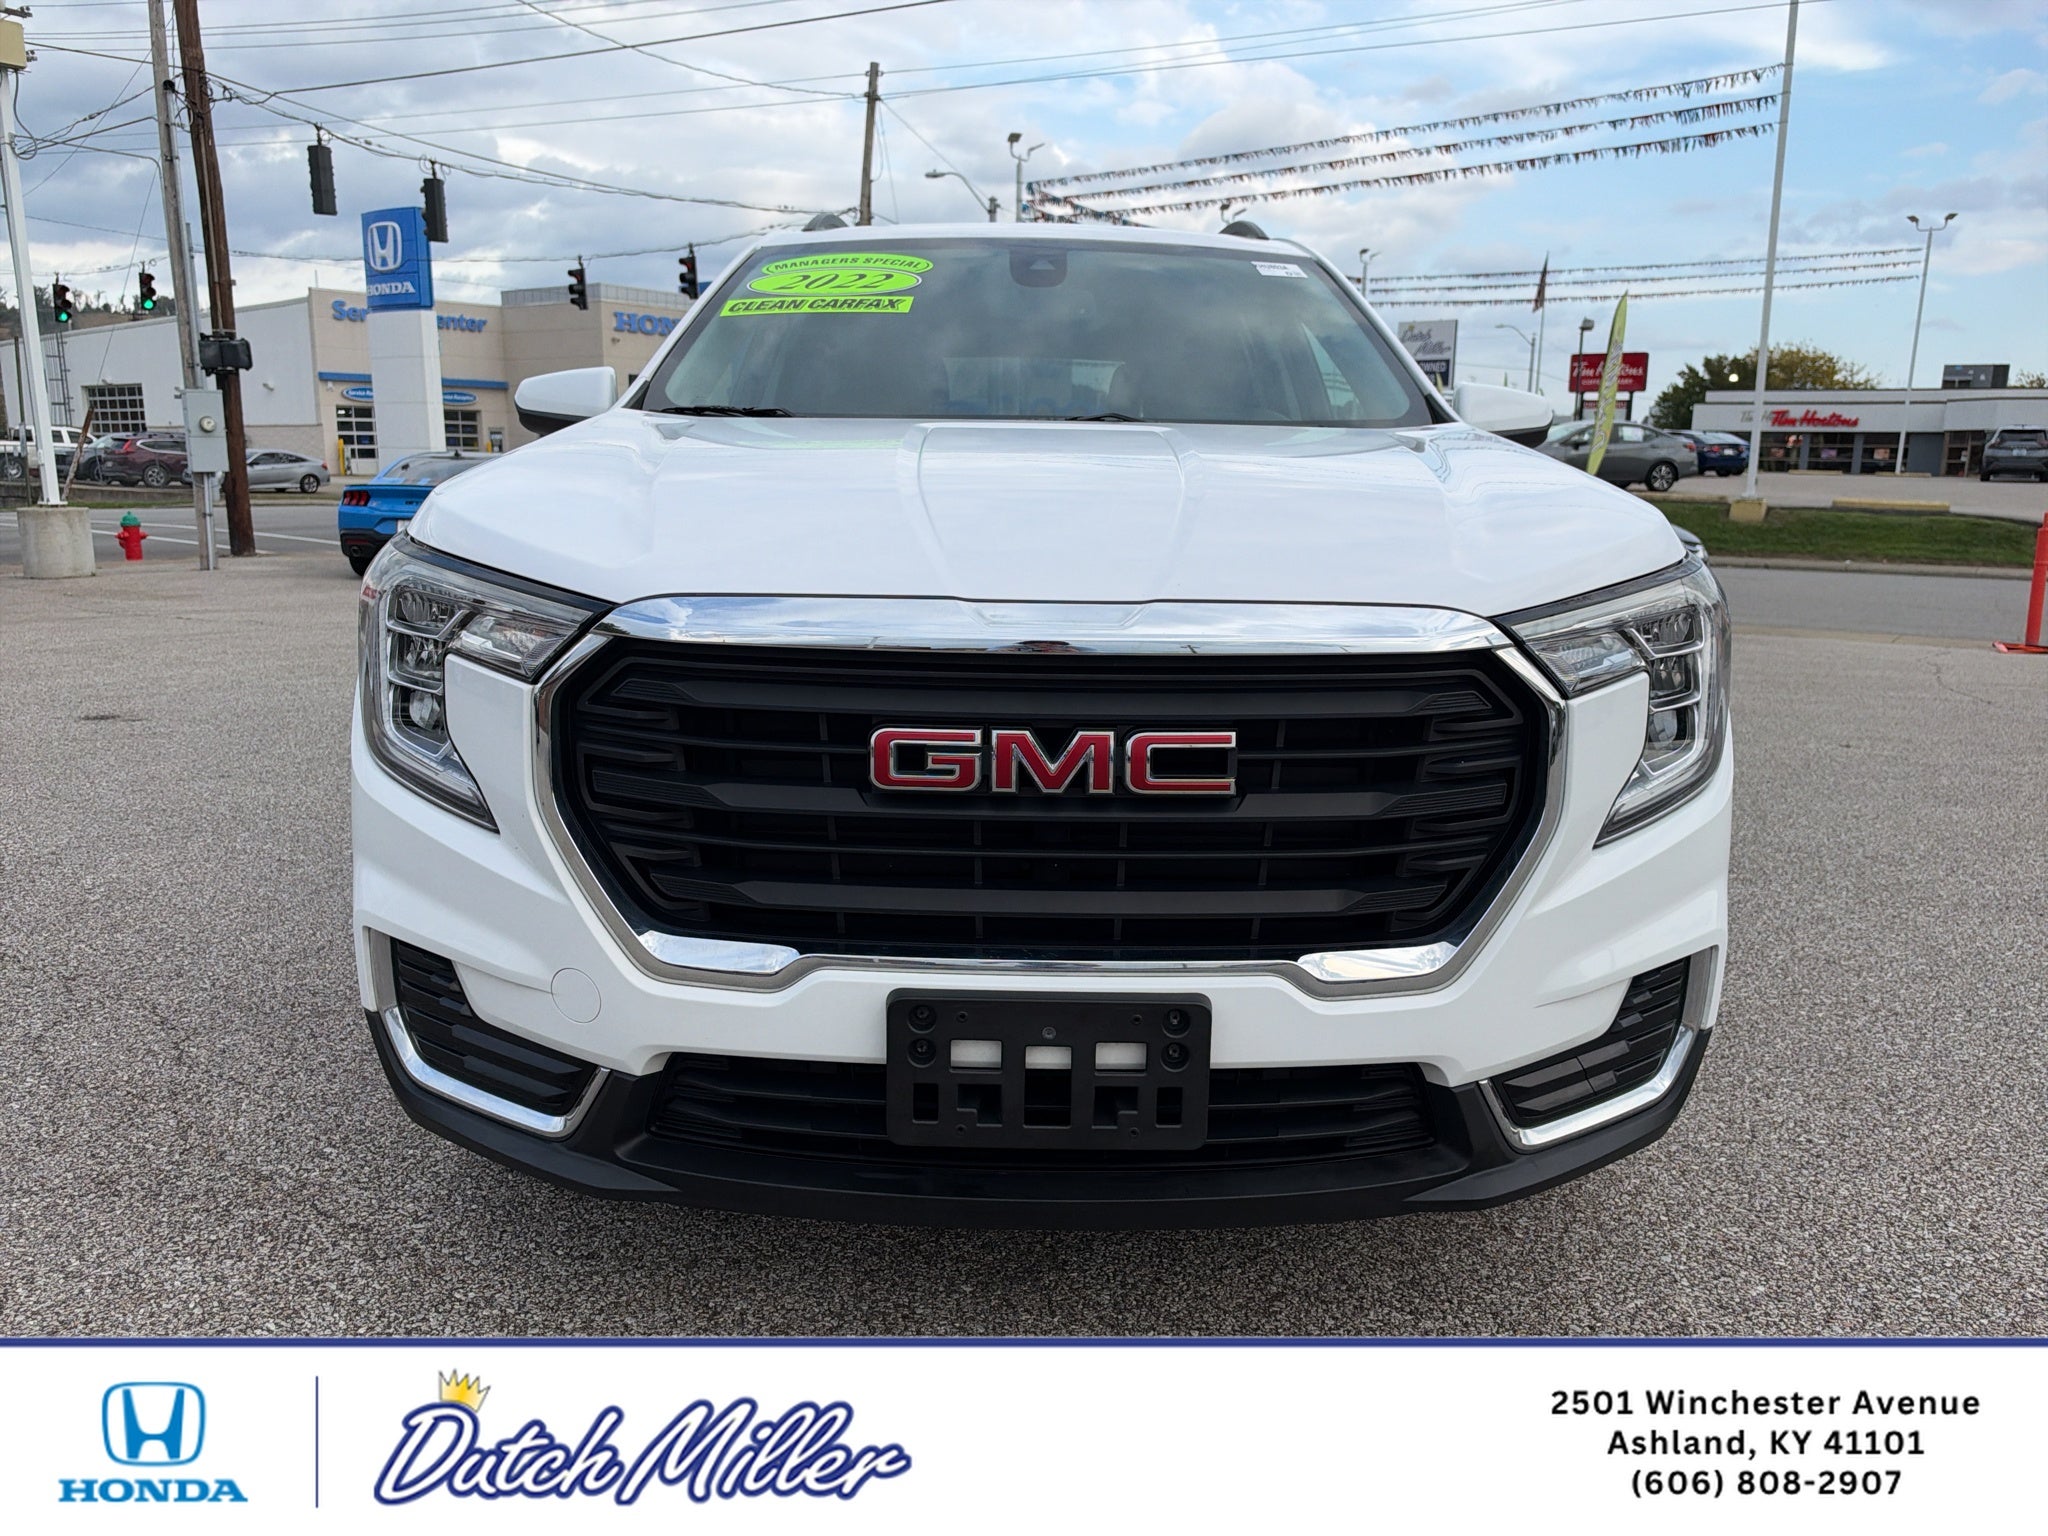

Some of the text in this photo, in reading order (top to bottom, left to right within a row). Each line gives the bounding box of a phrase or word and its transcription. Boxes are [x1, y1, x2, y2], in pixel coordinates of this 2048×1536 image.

[774, 256, 921, 271] MANAGERS SPECIAL
[772, 272, 895, 291] 2022
[331, 299, 488, 332] Ser enter
[727, 298, 904, 314] CLEAN CARFAX
[613, 310, 681, 336] HON
[1771, 409, 1798, 427] Tim
[1799, 408, 1859, 427] Hortons
[870, 727, 1237, 796] GMC
